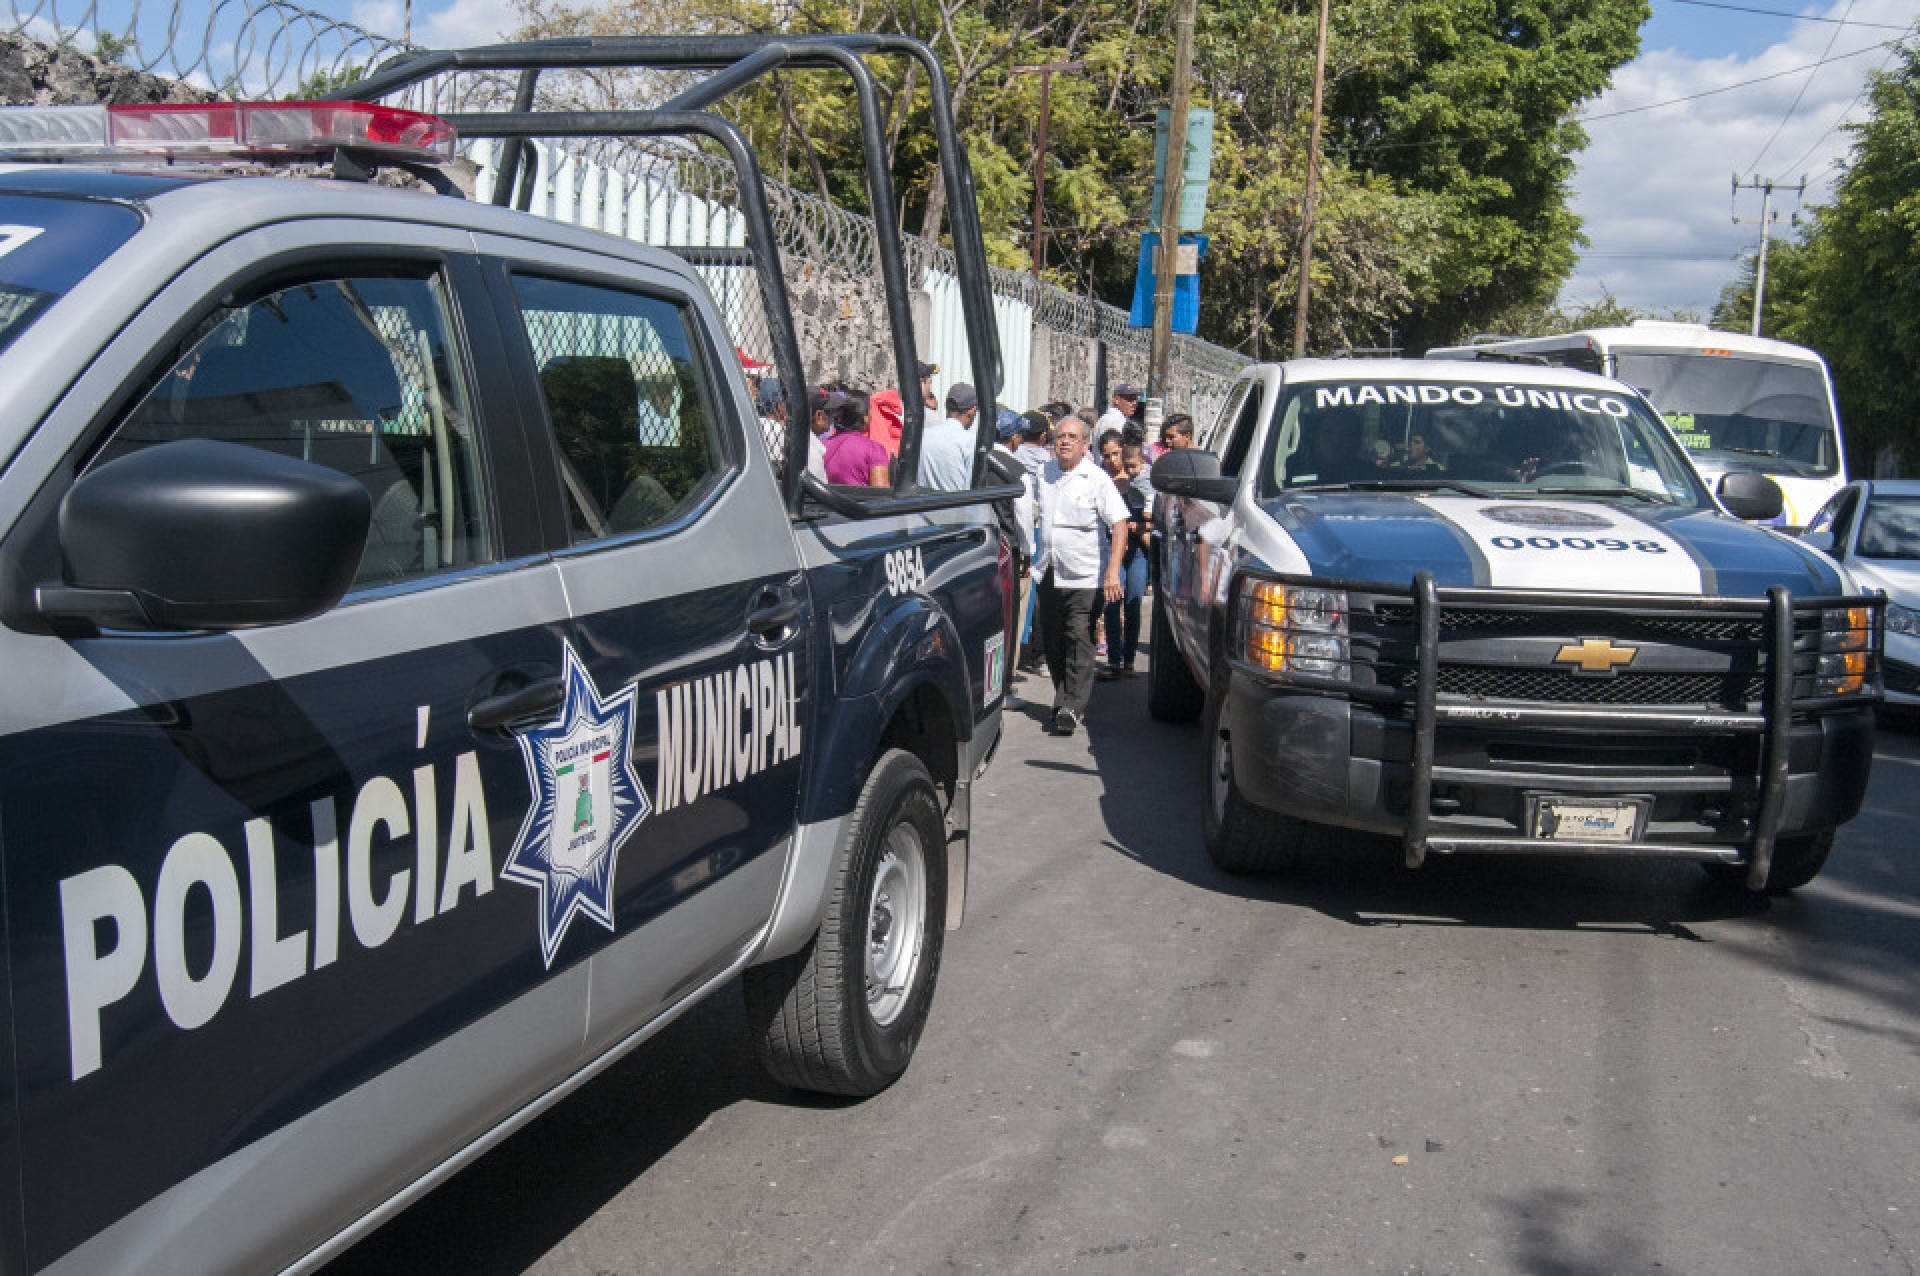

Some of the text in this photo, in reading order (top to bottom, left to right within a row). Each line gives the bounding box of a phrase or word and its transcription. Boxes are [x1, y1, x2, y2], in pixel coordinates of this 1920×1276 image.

[1316, 385, 1629, 417] MANDO ÚNICO
[1491, 535, 1668, 554] 00098
[884, 546, 925, 596] 9854
[59, 651, 800, 1081] POLICÍA MUNICIPAL
